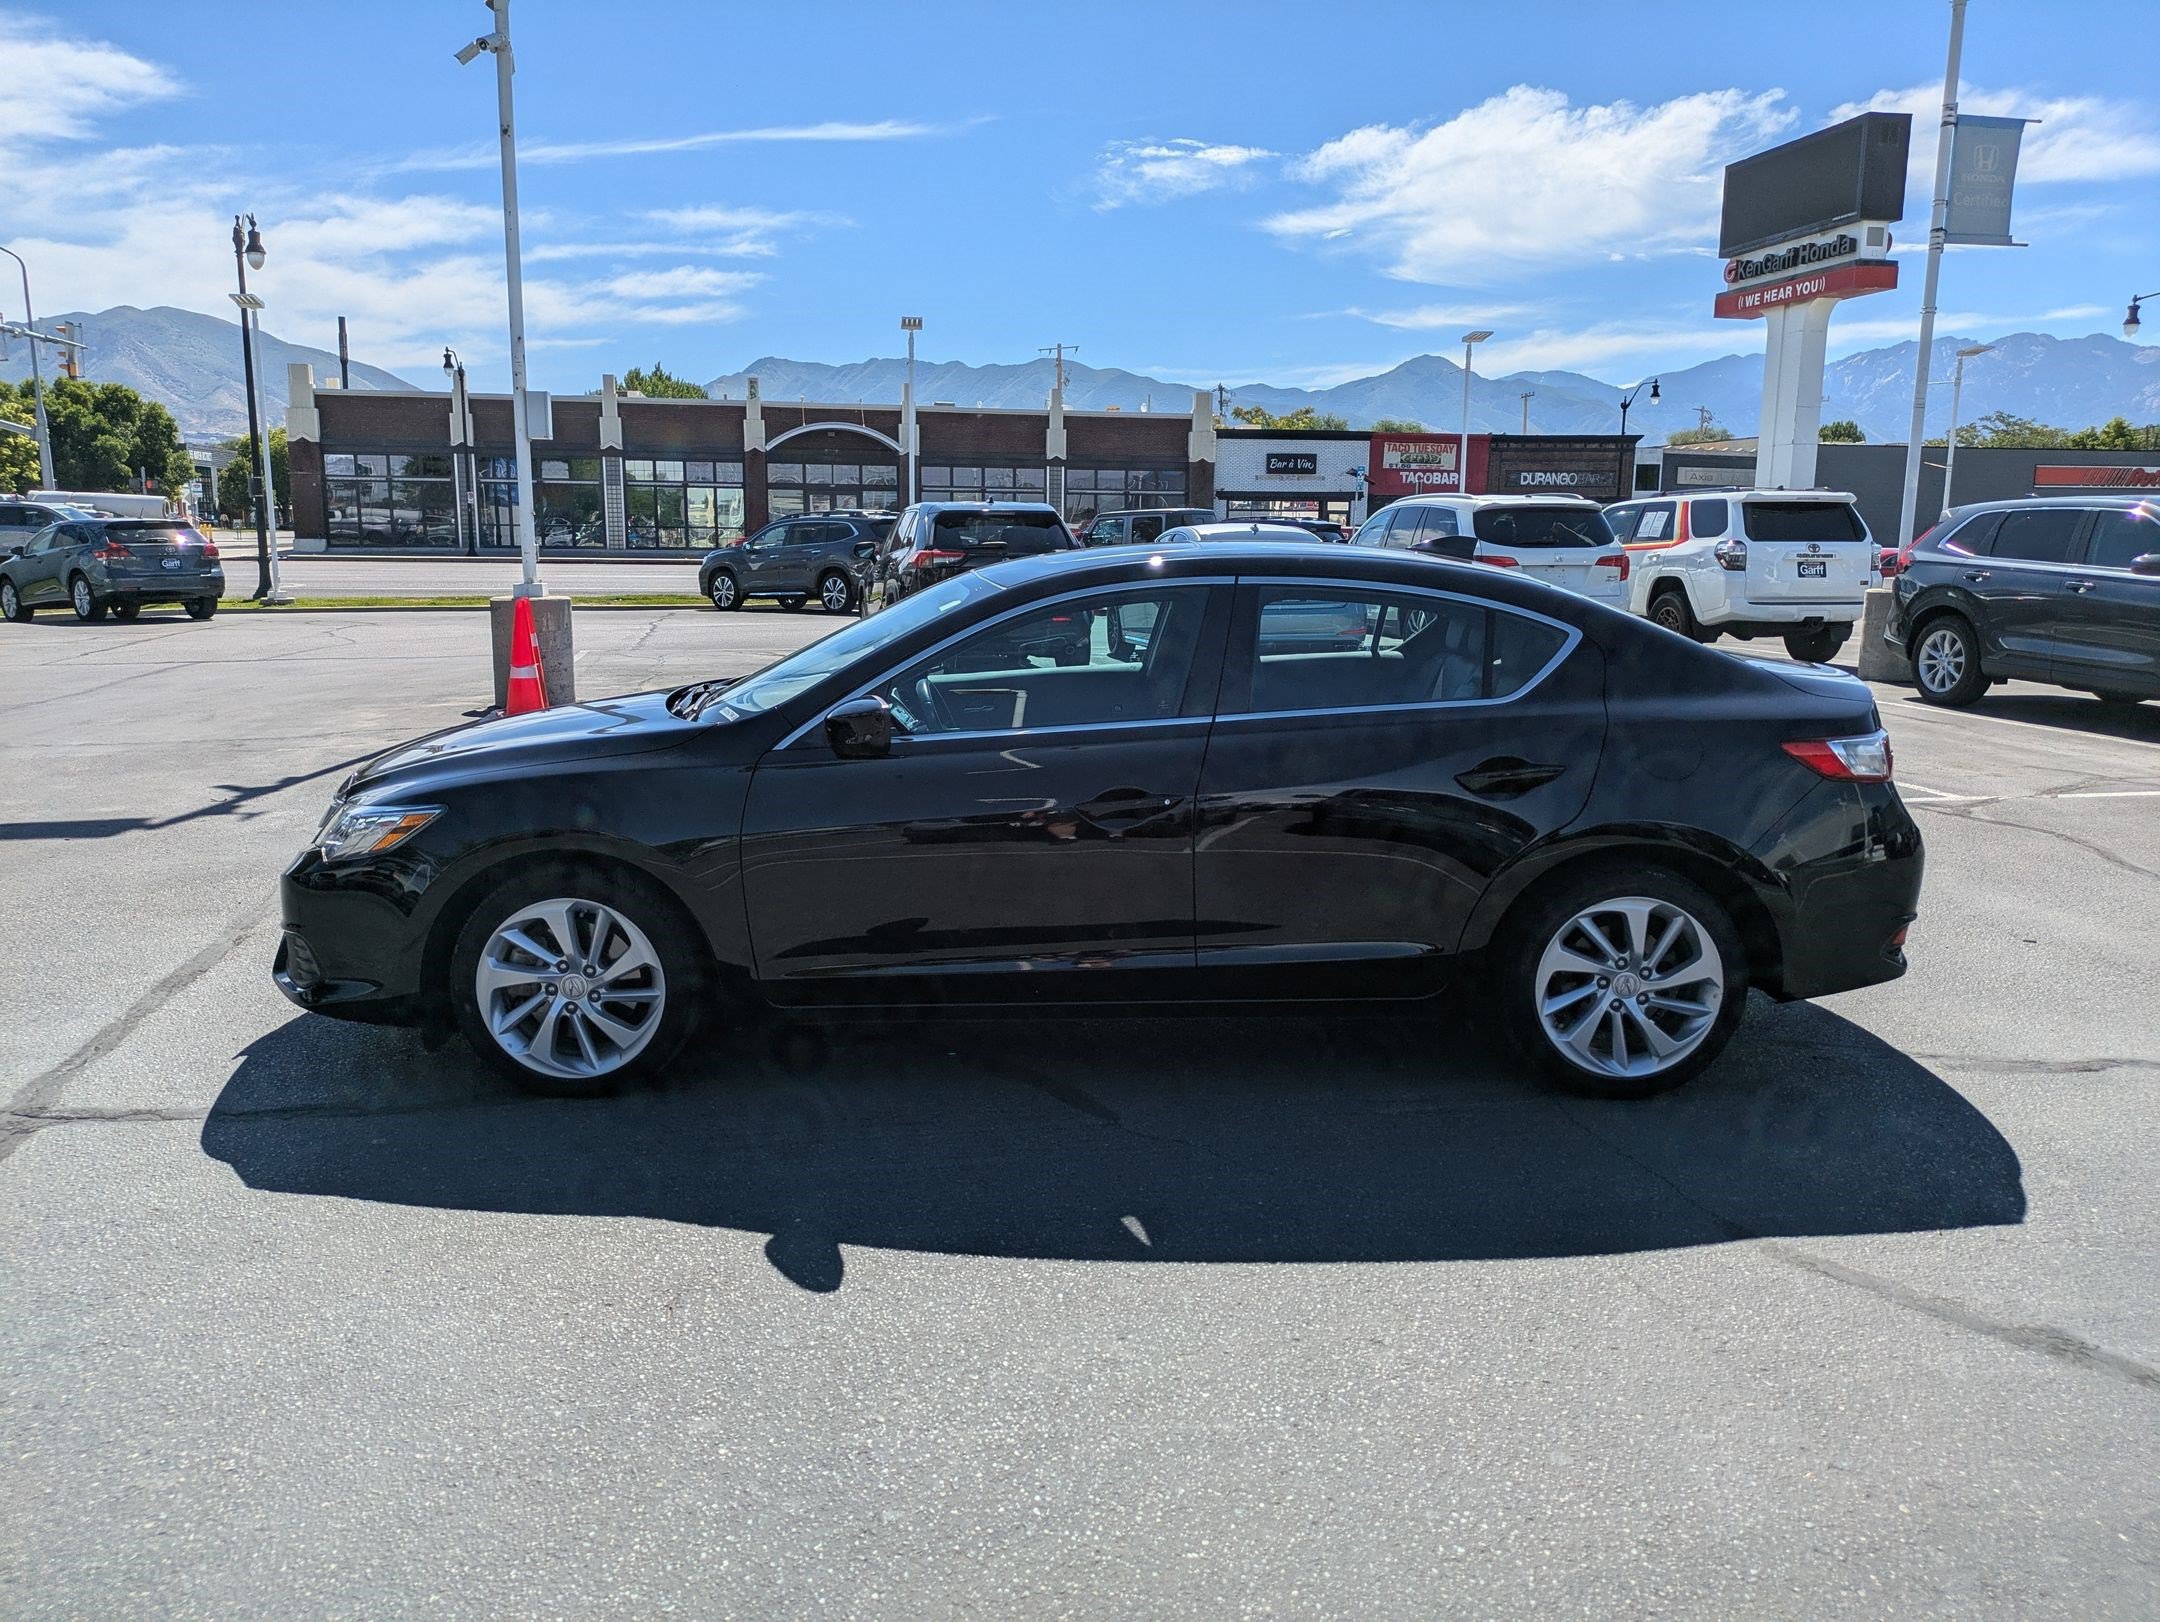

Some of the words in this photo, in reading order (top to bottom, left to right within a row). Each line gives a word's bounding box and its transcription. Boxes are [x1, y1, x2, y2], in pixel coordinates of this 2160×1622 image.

[1799, 235, 1852, 264] Honda
[1763, 286, 1793, 303] HEAR
[1386, 443, 1411, 453] TACO
[1413, 444, 1455, 455] TUESDAY
[1270, 459, 1287, 469] Bar
[1297, 459, 1315, 470] Vin
[1520, 472, 1577, 486] DURANGO
[1800, 564, 1824, 575] Garff
